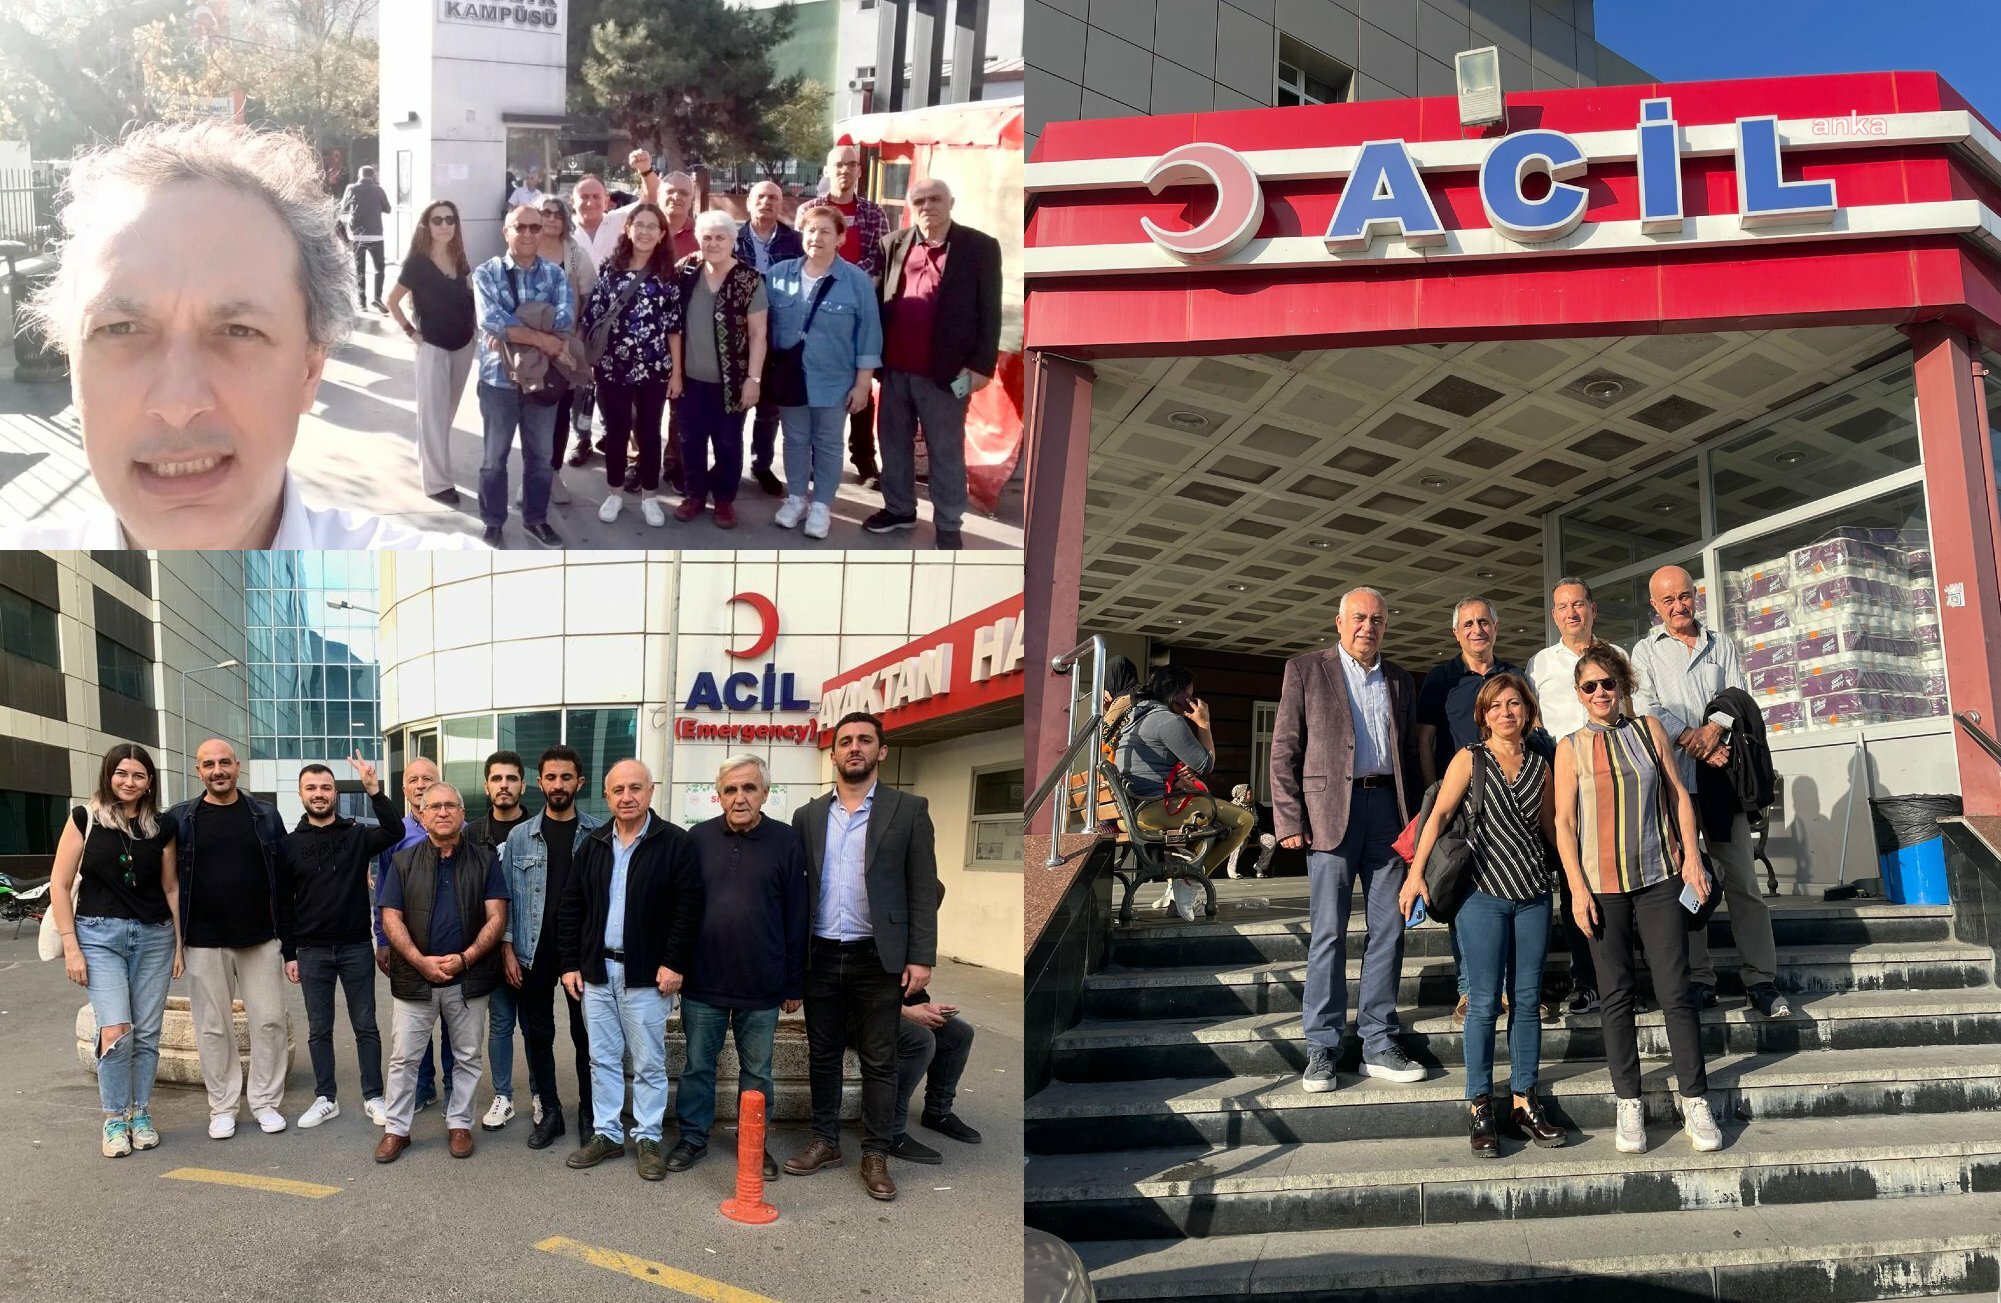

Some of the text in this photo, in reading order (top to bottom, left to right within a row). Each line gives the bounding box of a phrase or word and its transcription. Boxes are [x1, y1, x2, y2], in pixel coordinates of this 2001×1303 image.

[444, 1, 558, 27] KAMPÜSÜ
[1324, 97, 1838, 254] ACİL
[684, 663, 811, 711] ACİL
[817, 643, 954, 733] AYAKTAN
[675, 717, 818, 745] (Emergency)
